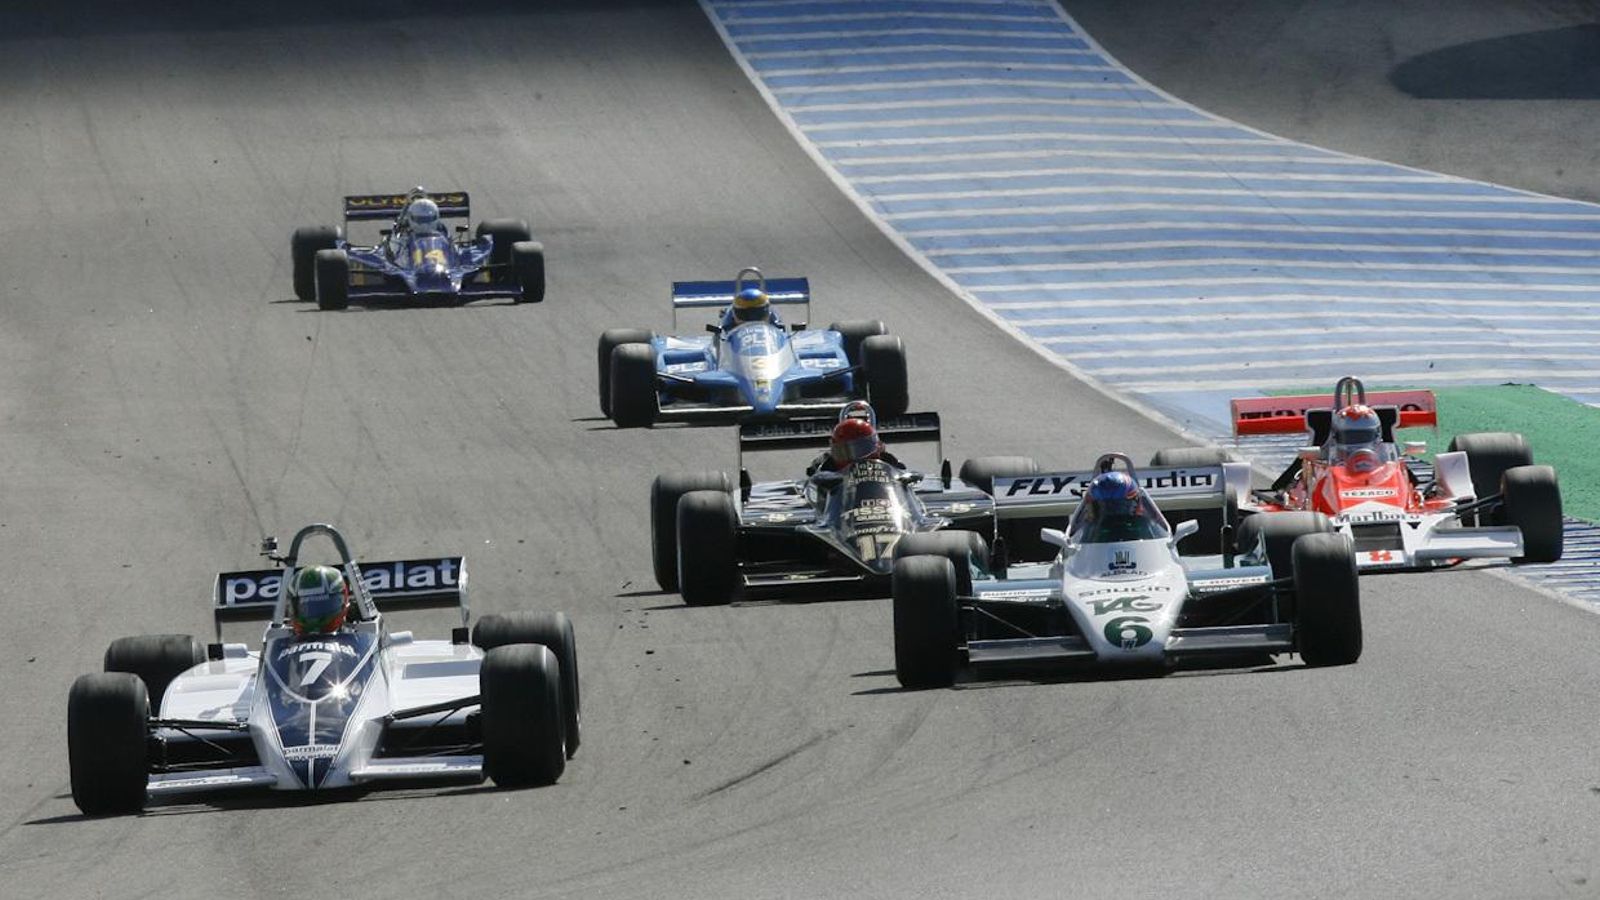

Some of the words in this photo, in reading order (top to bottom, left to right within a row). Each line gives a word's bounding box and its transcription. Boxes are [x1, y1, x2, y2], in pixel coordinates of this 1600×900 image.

[1007, 475, 1077, 497] FLY
[1343, 488, 1394, 497] TEXACO
[1335, 511, 1420, 523] Marlboro
[857, 533, 901, 562] 17
[1369, 550, 1393, 562] 8
[1086, 595, 1163, 616] TAG
[1104, 616, 1153, 648] 6
[277, 641, 357, 661] parmalat
[299, 651, 333, 687] 7
